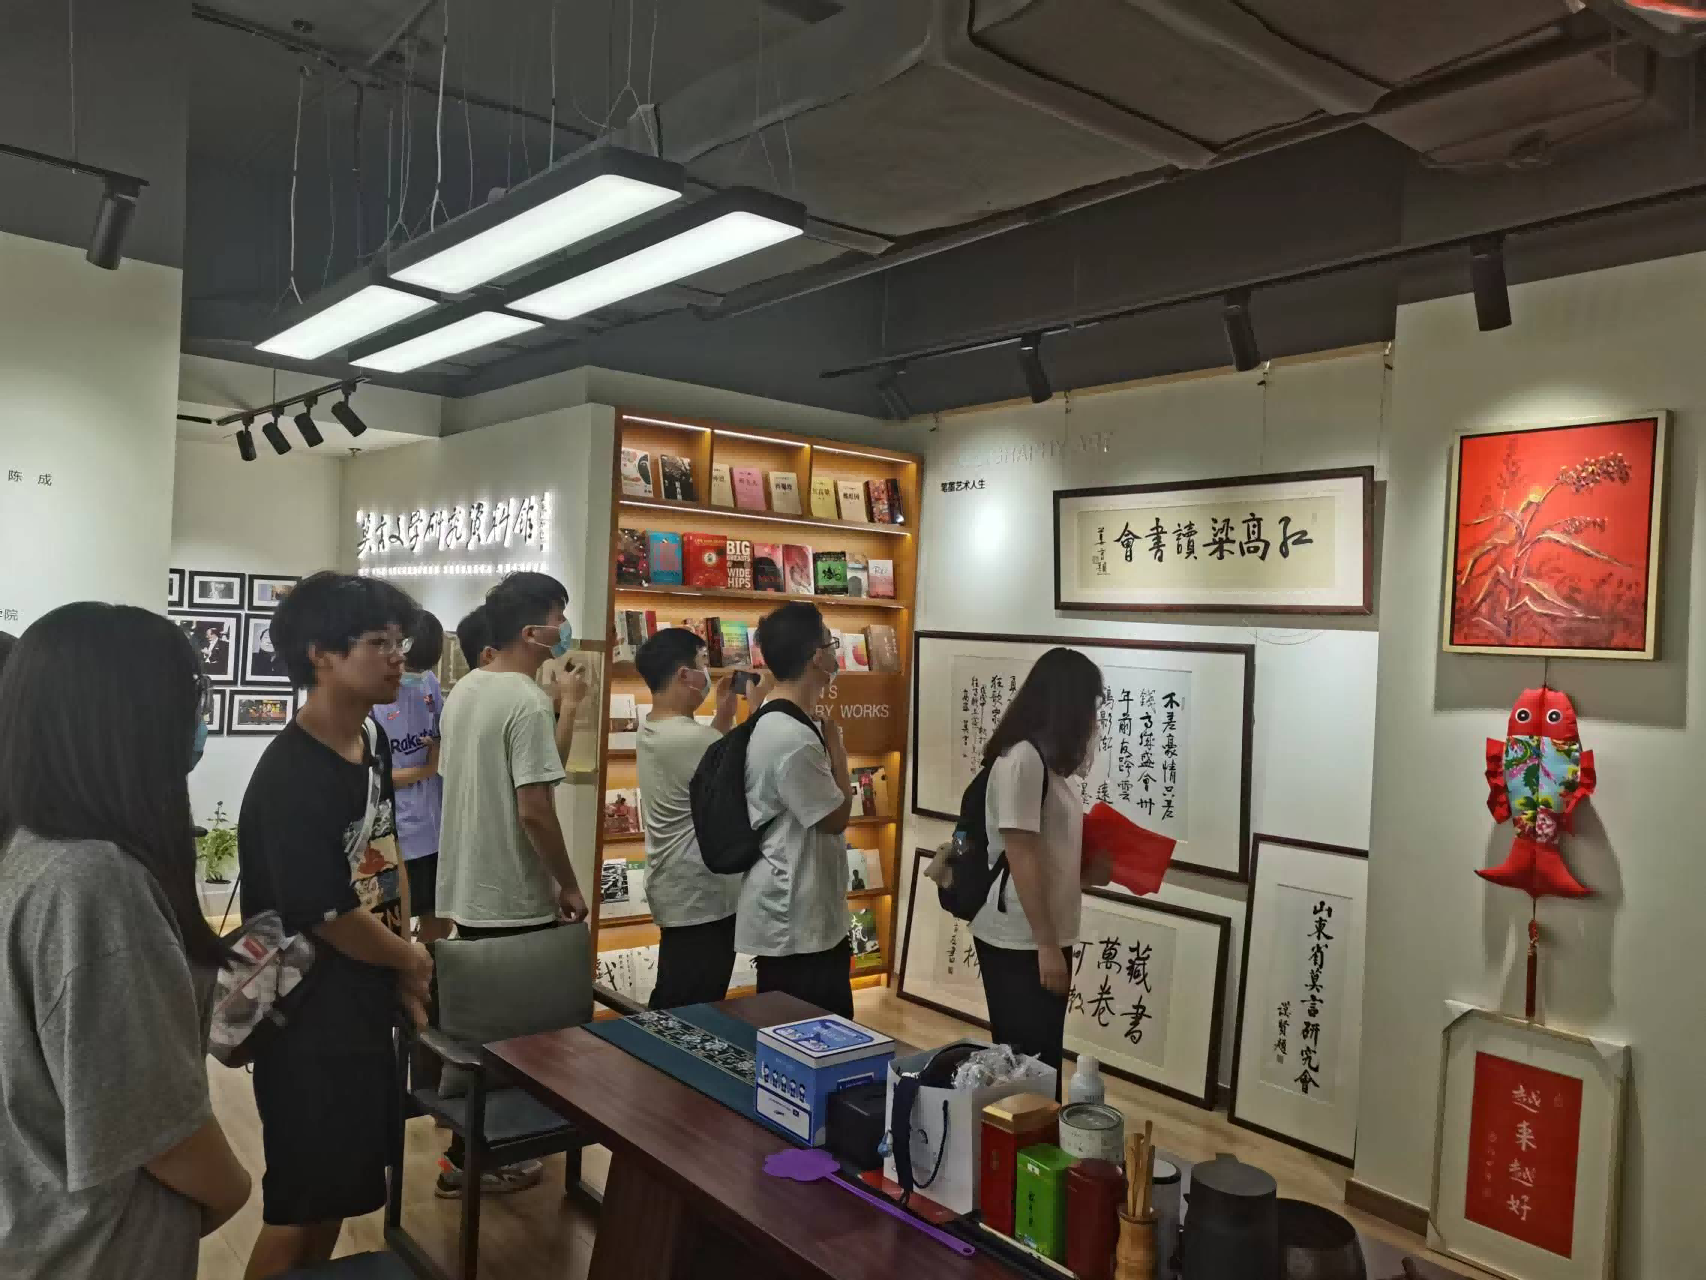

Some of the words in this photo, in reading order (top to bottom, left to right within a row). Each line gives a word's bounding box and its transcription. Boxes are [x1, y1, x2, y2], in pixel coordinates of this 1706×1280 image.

[726, 541, 750, 555] BIG
[727, 568, 751, 578] WIDE
[727, 577, 751, 588] HIPS
[840, 704, 889, 718] WORKS
